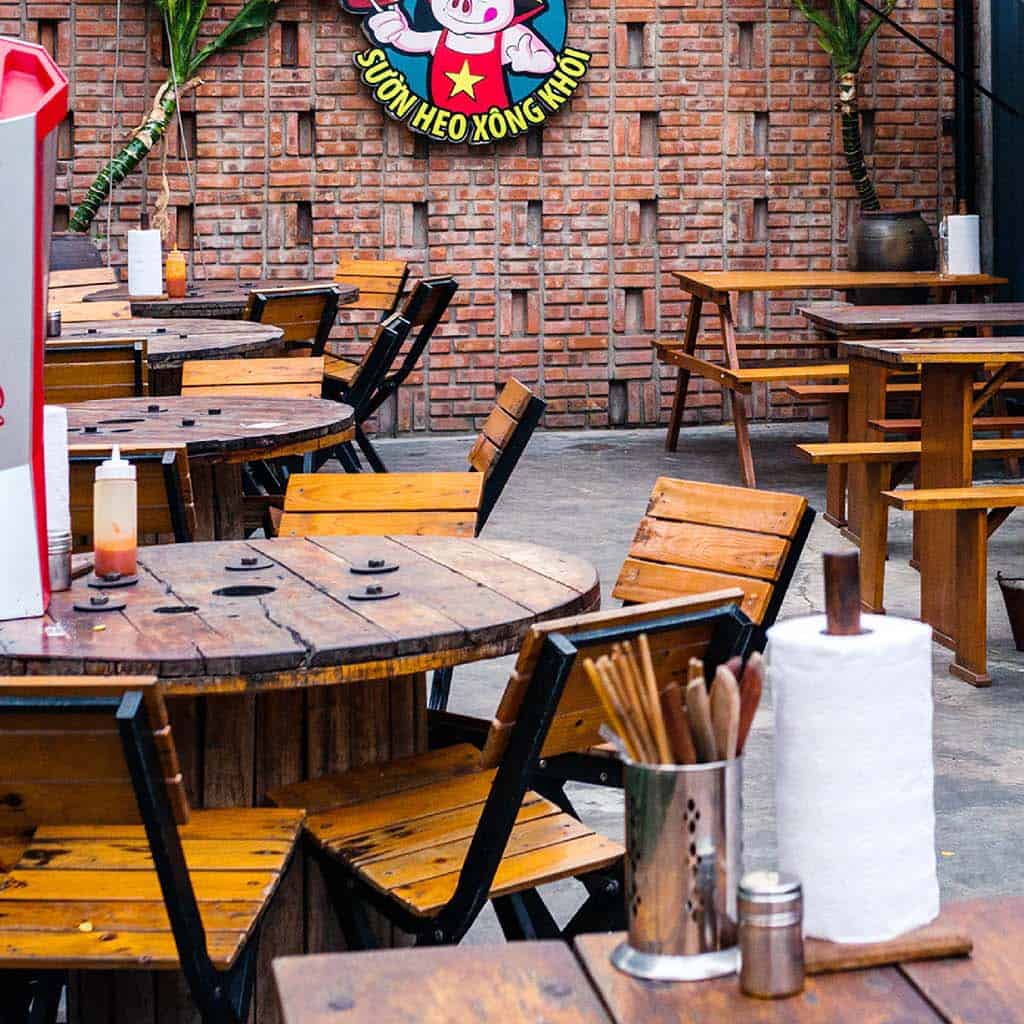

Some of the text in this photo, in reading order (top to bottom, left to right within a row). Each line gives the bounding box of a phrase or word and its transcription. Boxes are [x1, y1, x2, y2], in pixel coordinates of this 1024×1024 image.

[412, 102, 467, 141] HEO
[473, 97, 546, 142] XÔNG
[538, 47, 592, 110] KHÓI
